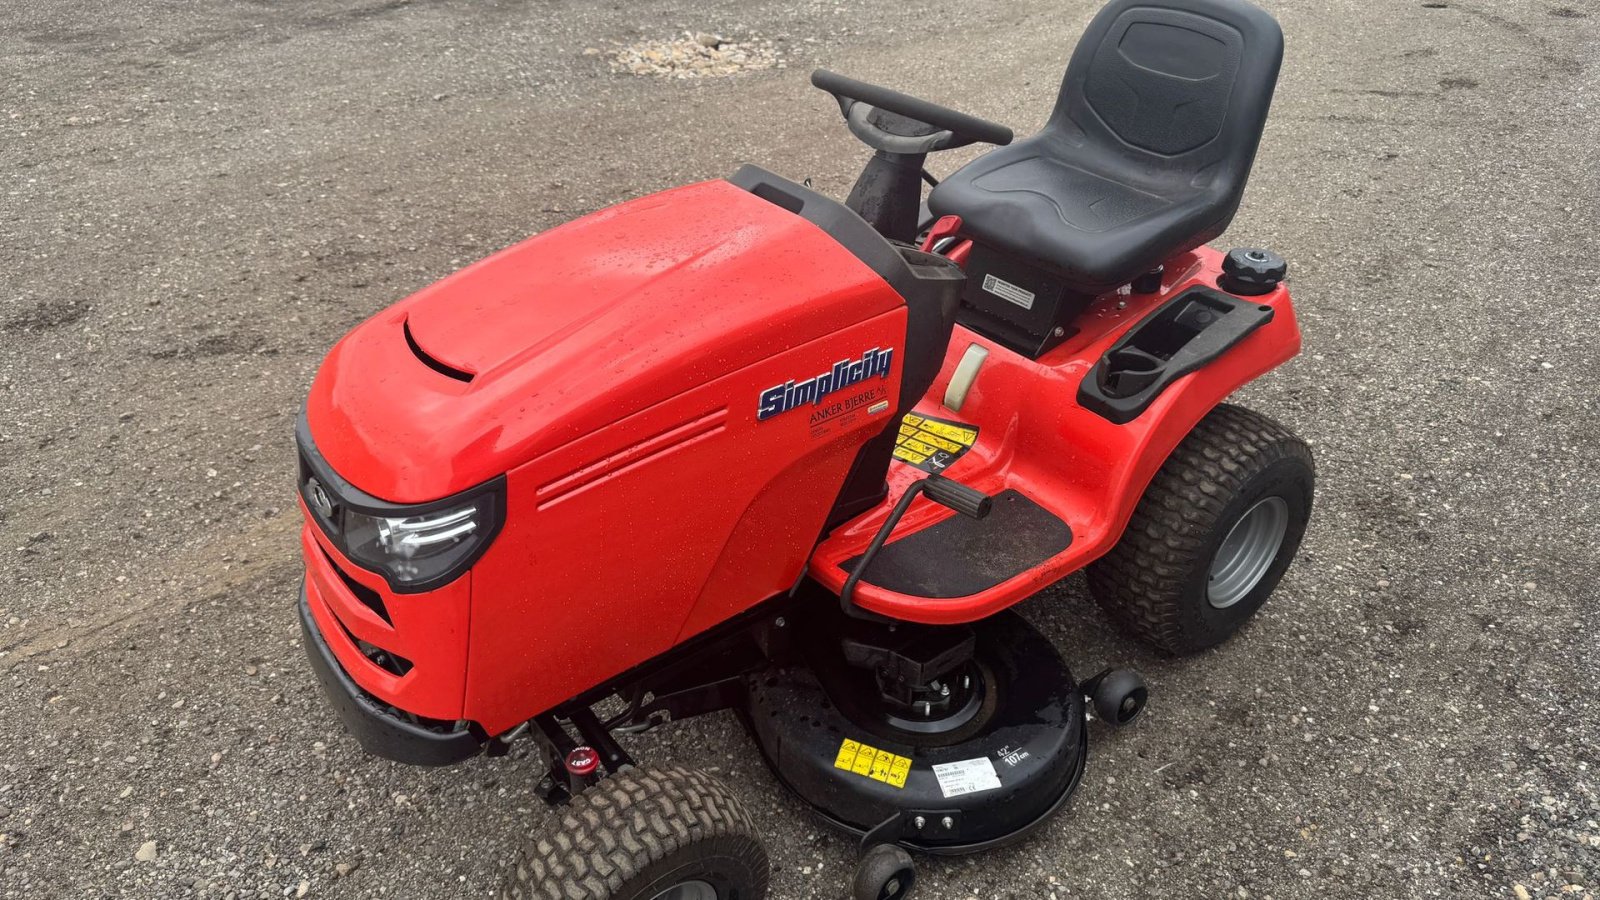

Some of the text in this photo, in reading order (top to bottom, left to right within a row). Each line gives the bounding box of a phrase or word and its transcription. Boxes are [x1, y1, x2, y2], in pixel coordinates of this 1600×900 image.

[757, 347, 893, 420] Simplicity
[810, 403, 843, 423] ANKER
[845, 390, 875, 409] BJERRE
[571, 758, 591, 766] CAST
